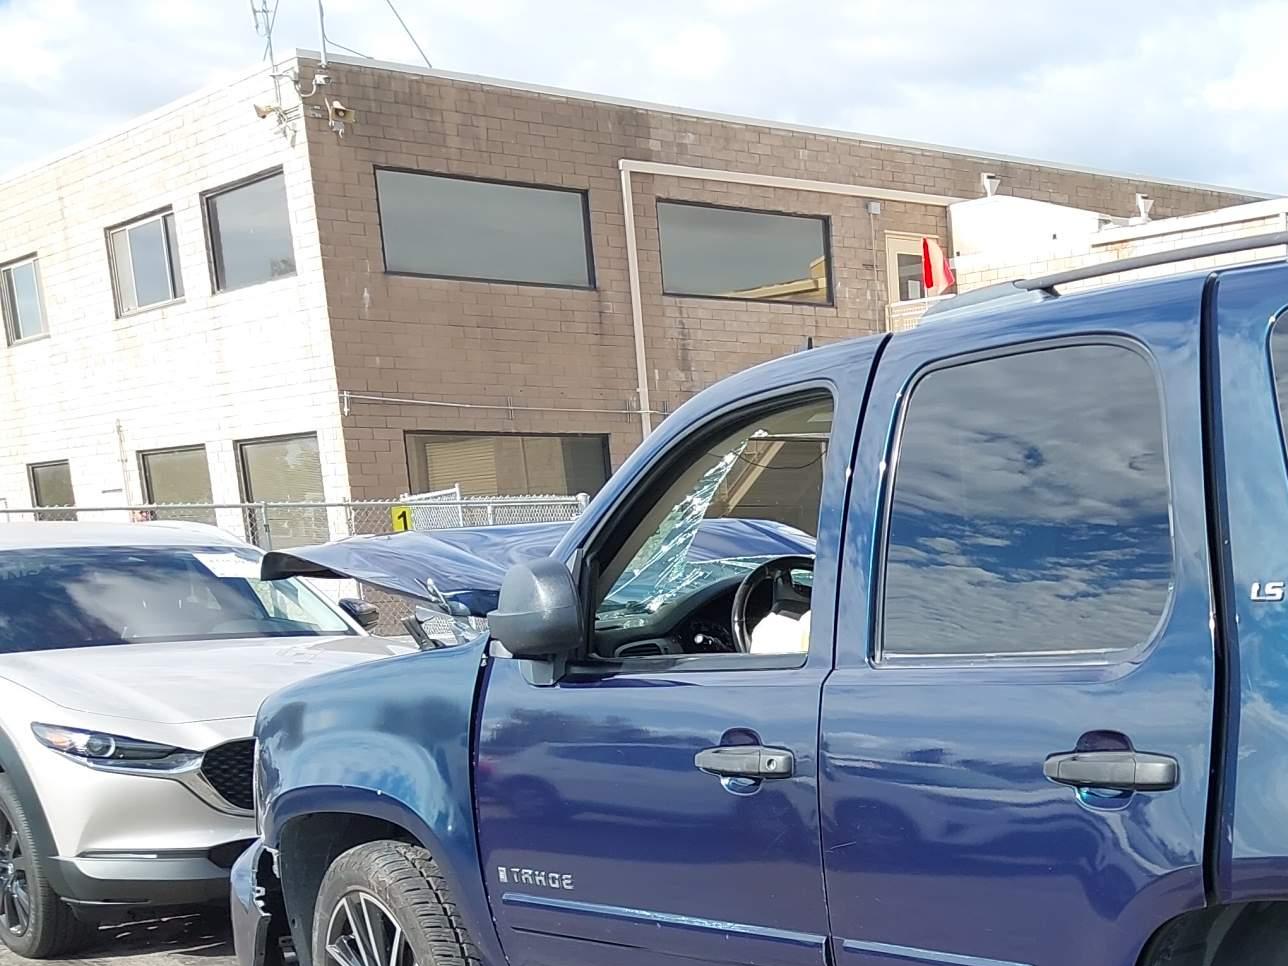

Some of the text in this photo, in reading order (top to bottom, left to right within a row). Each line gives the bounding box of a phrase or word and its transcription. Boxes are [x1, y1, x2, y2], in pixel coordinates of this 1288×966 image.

[397, 510, 408, 531] 1
[1250, 581, 1285, 602] LS
[510, 867, 575, 890] TAHOE
